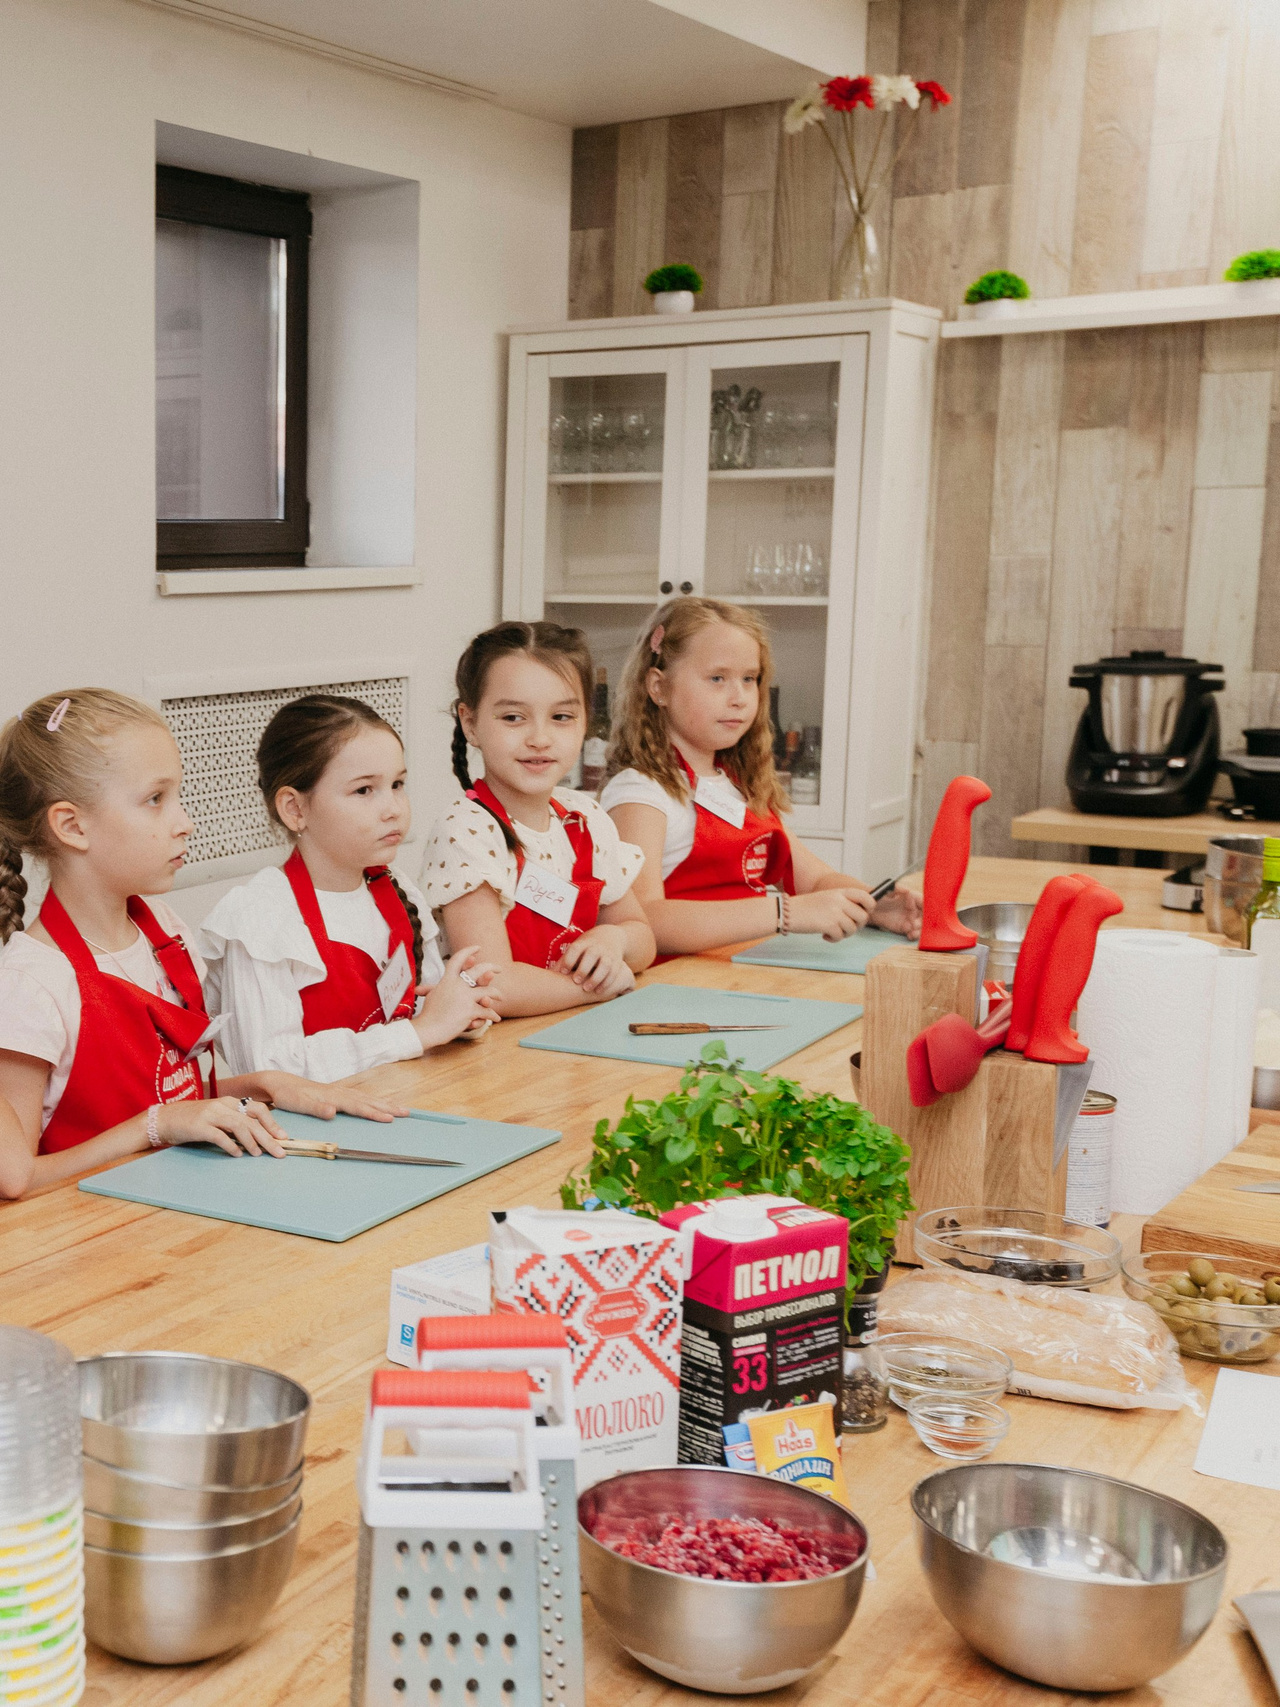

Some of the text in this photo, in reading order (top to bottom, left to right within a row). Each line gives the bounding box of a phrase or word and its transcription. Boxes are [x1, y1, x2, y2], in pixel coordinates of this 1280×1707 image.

[734, 1245, 841, 1301] ПЕТМОЛ
[403, 1326, 412, 1339] S
[575, 1391, 664, 1440] МОЛОКО
